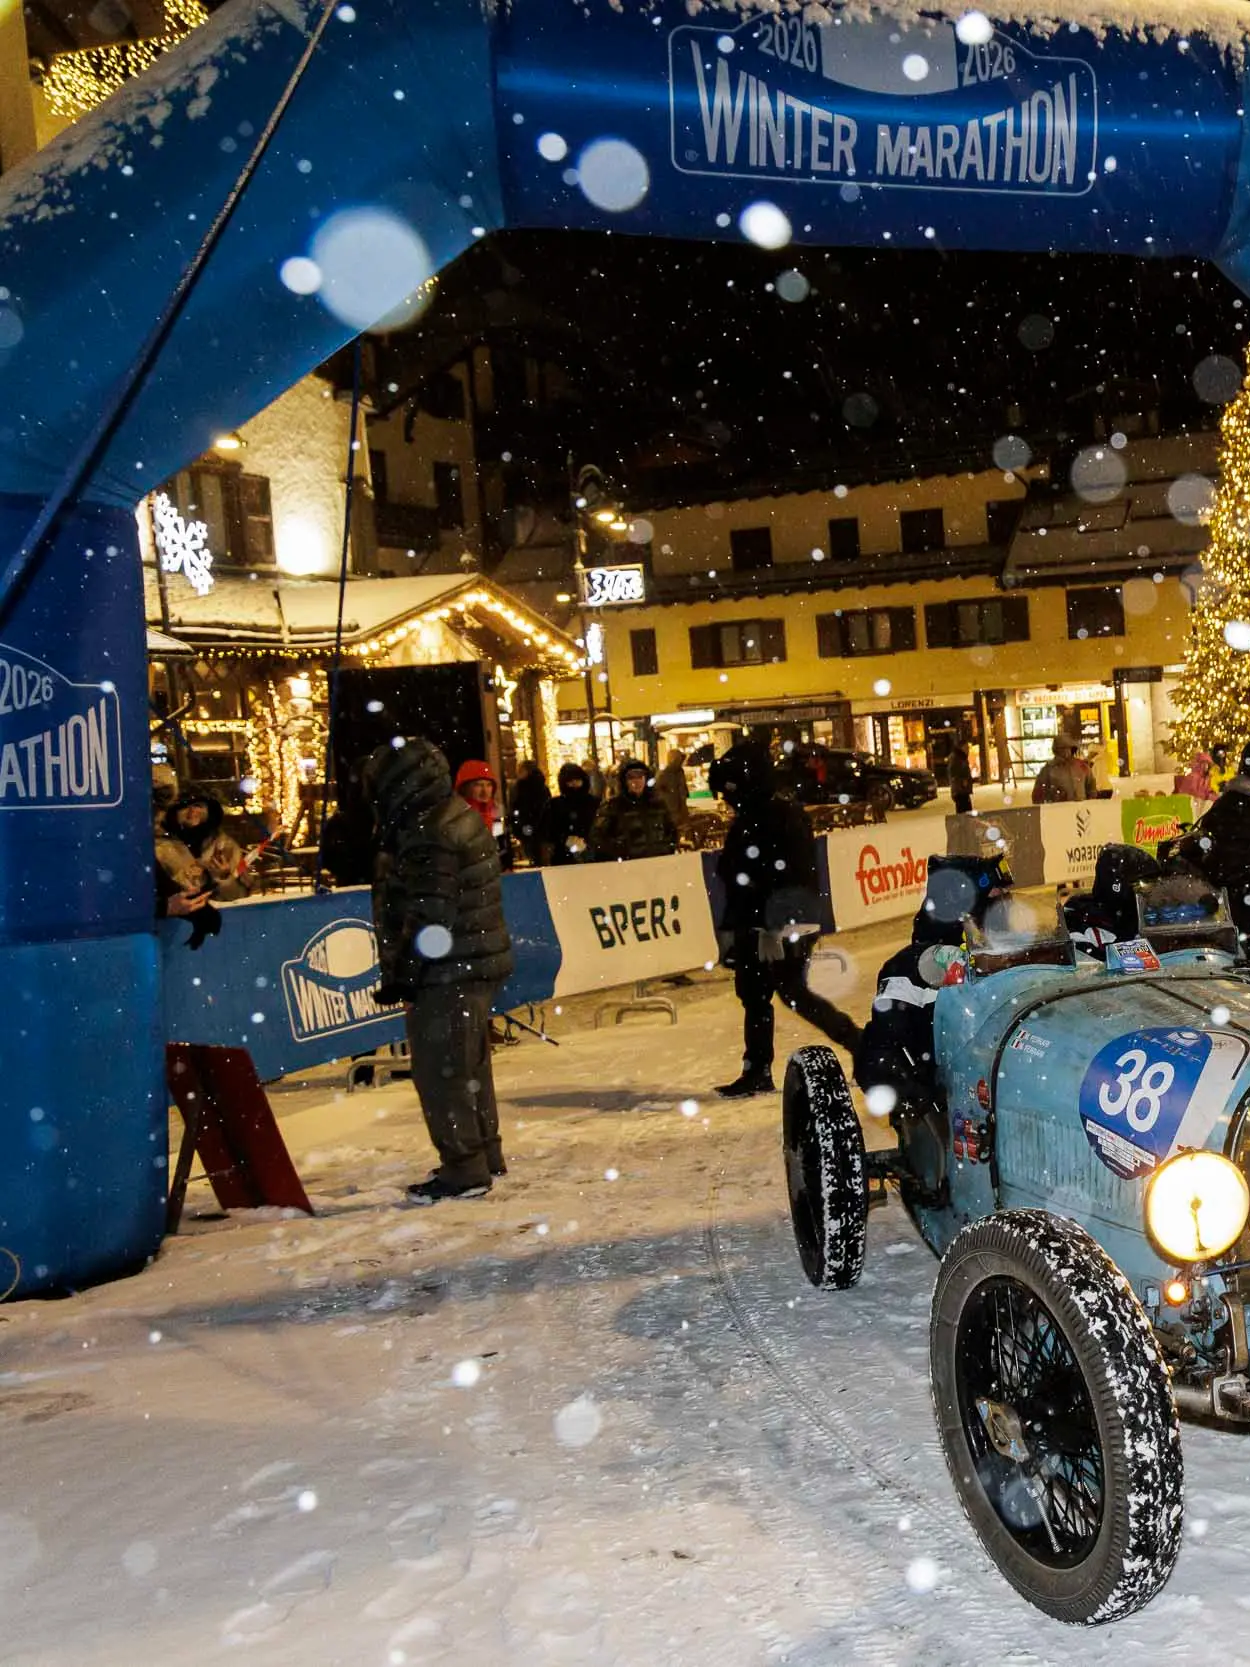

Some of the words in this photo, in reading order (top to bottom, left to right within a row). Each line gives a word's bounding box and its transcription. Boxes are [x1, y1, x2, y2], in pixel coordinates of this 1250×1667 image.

[758, 17, 817, 73] 2026
[963, 40, 1016, 87] 2026
[690, 39, 858, 173] WINTER
[876, 72, 1078, 184] MARATHON
[0, 658, 54, 716] 2026
[856, 844, 927, 906] famila
[289, 968, 351, 1033] WINTER
[1098, 1048, 1175, 1133] 38
